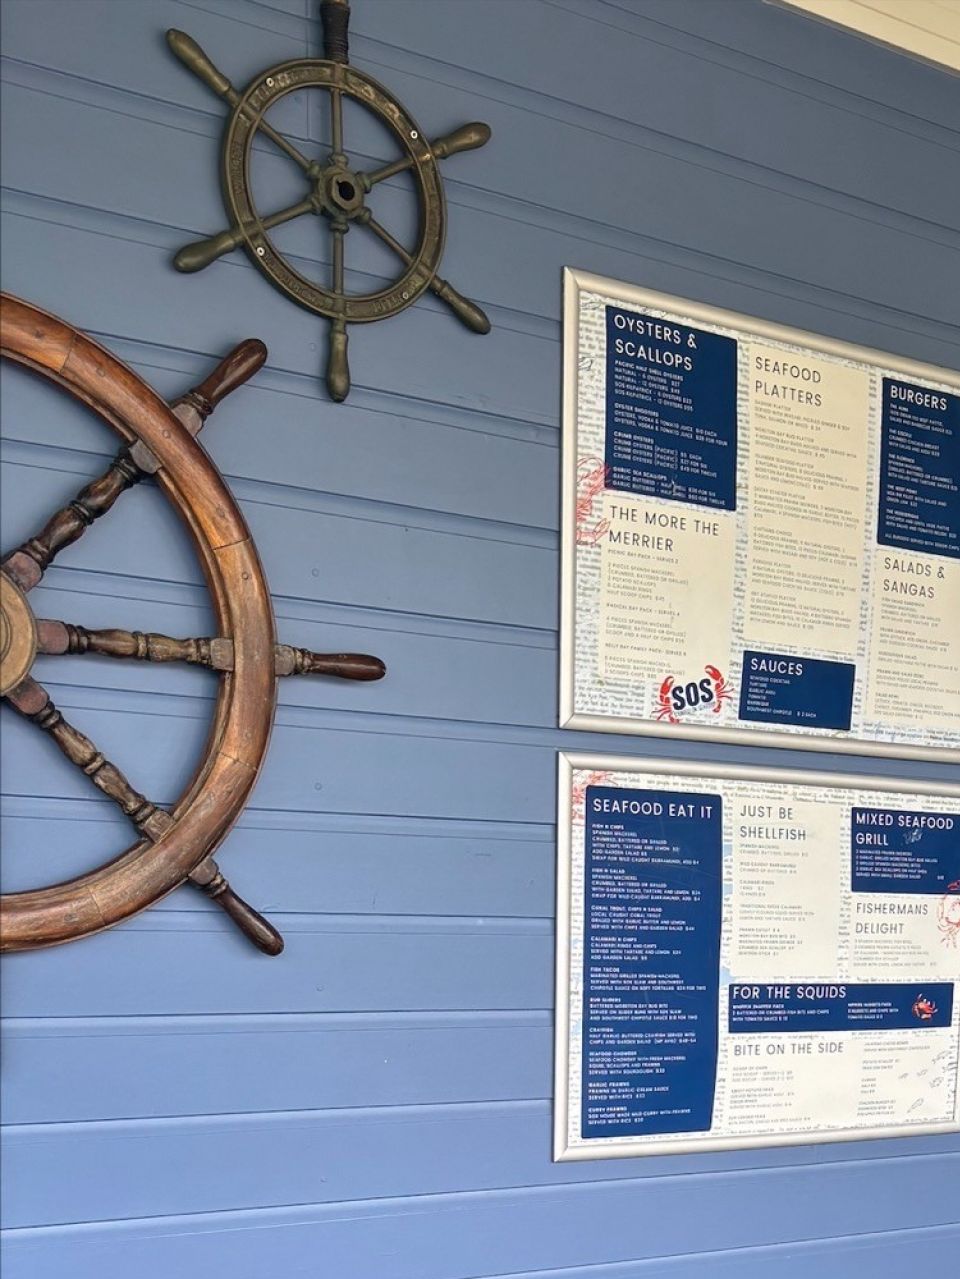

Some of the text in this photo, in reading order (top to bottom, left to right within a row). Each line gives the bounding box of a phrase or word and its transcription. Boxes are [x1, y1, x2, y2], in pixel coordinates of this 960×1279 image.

[614, 315, 697, 349] OYSTERS &
[615, 339, 693, 371] SCALLOPS
[755, 356, 821, 383] SEAFOOD
[755, 380, 822, 407] PLATTERS
[890, 385, 947, 411] BURGERS
[610, 505, 719, 537] THE MORE THE
[609, 529, 673, 552] MERRIER
[884, 557, 944, 579] SALADS &
[883, 578, 935, 599] SANGAS
[750, 658, 803, 676] SAUCES
[672, 678, 714, 710] SOS
[593, 798, 712, 819] SEAFOOD EAT IT
[740, 805, 793, 820] JUST BE
[856, 812, 954, 830] MIXED SEAFOOD
[740, 825, 806, 841] SHELLFISH
[855, 832, 889, 846] GRILL
[856, 902, 928, 915] FISHERMANS
[855, 922, 904, 935] DELIGHT
[733, 985, 847, 1000] FOR THE SQUIDS
[734, 1041, 844, 1056] BITE ON THE SIDE
